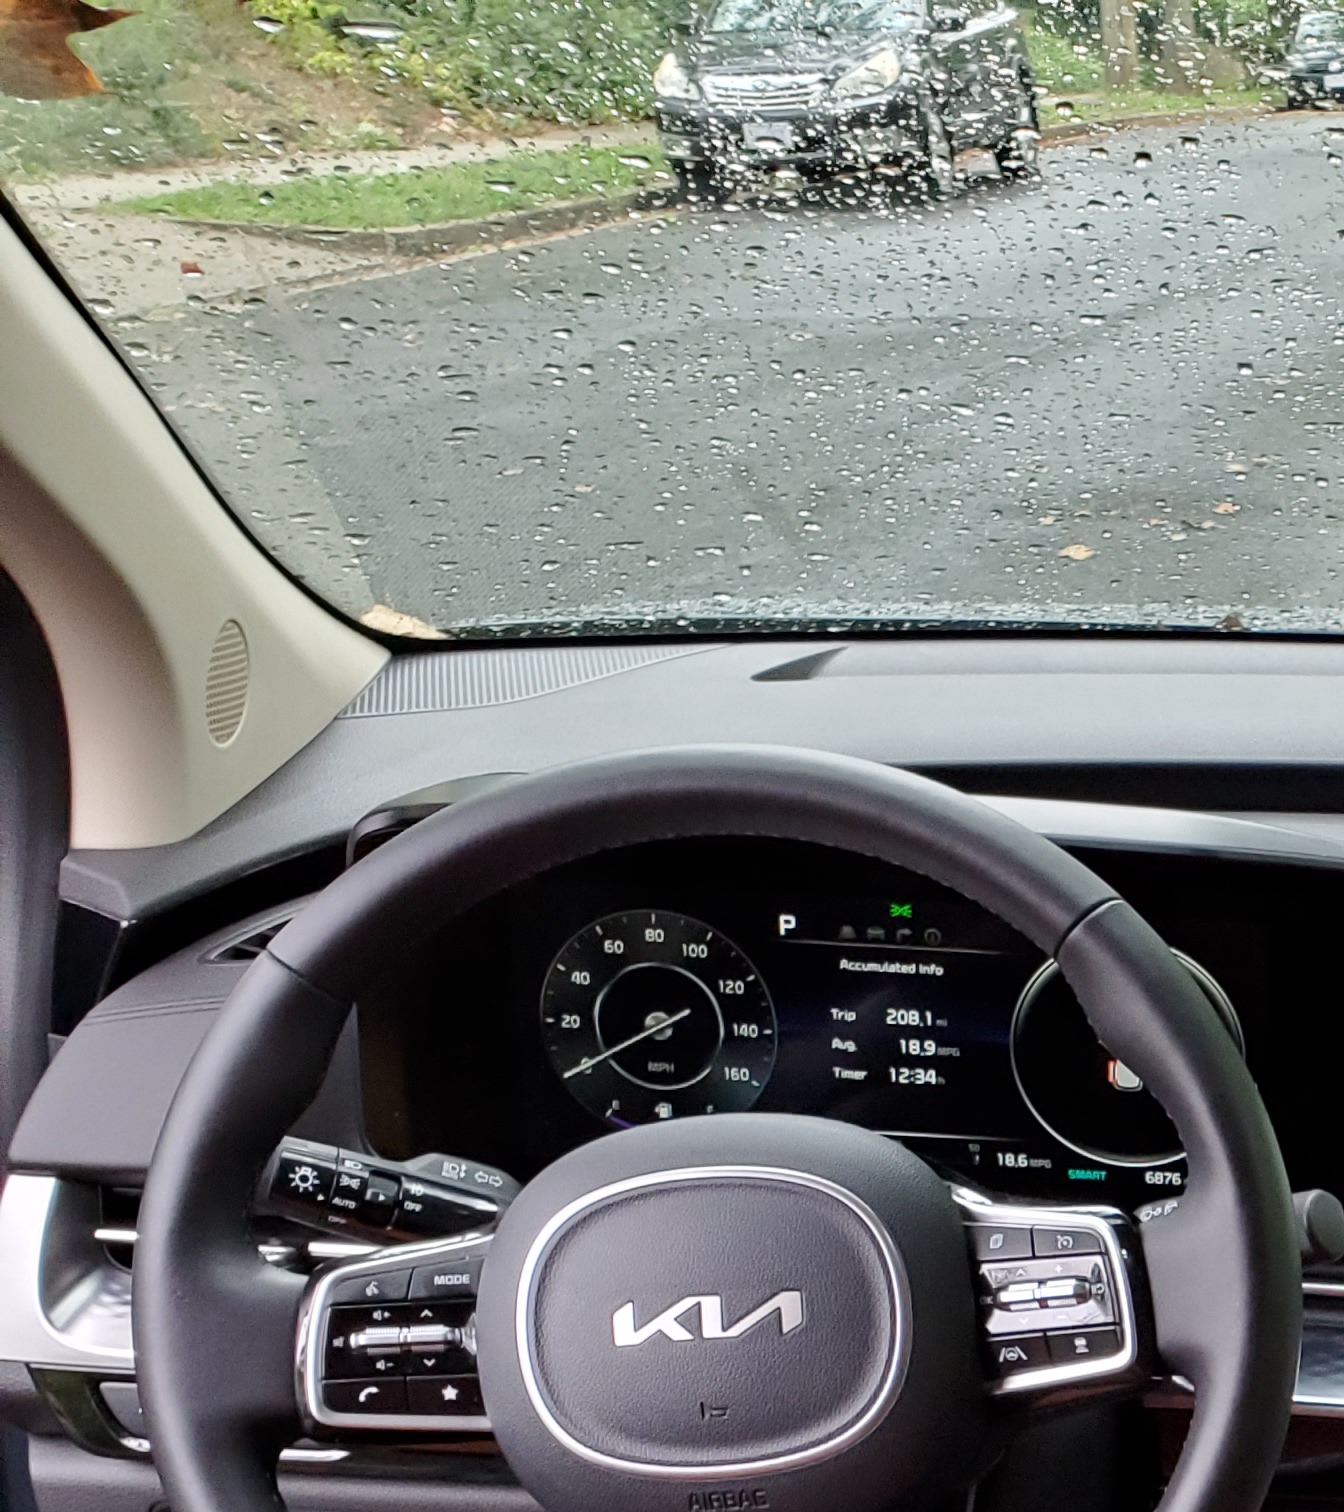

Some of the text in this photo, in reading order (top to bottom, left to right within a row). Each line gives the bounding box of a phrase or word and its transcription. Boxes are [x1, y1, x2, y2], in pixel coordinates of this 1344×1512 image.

[779, 914, 796, 936] P
[645, 929, 664, 942] 80
[604, 940, 624, 954] 60
[682, 944, 708, 958] 100
[839, 959, 944, 976] Accumulated Info
[571, 971, 590, 985] 40
[718, 980, 744, 994] 120
[561, 1015, 580, 1028] 20
[830, 1008, 856, 1021] Trip
[886, 1009, 932, 1026] 208.1
[733, 1024, 758, 1038] 140
[900, 1040, 935, 1056] 18.9
[648, 1062, 674, 1073] MPH
[724, 1067, 749, 1081] 160
[833, 1066, 936, 1085] Timer 12:34
[997, 1153, 1028, 1167] 18.6
[1068, 1170, 1106, 1181] SMART
[1145, 1172, 1182, 1185] 6876
[332, 1196, 356, 1209] AUTO
[434, 1274, 470, 1286] MODE
[612, 1290, 803, 1347] KIA
